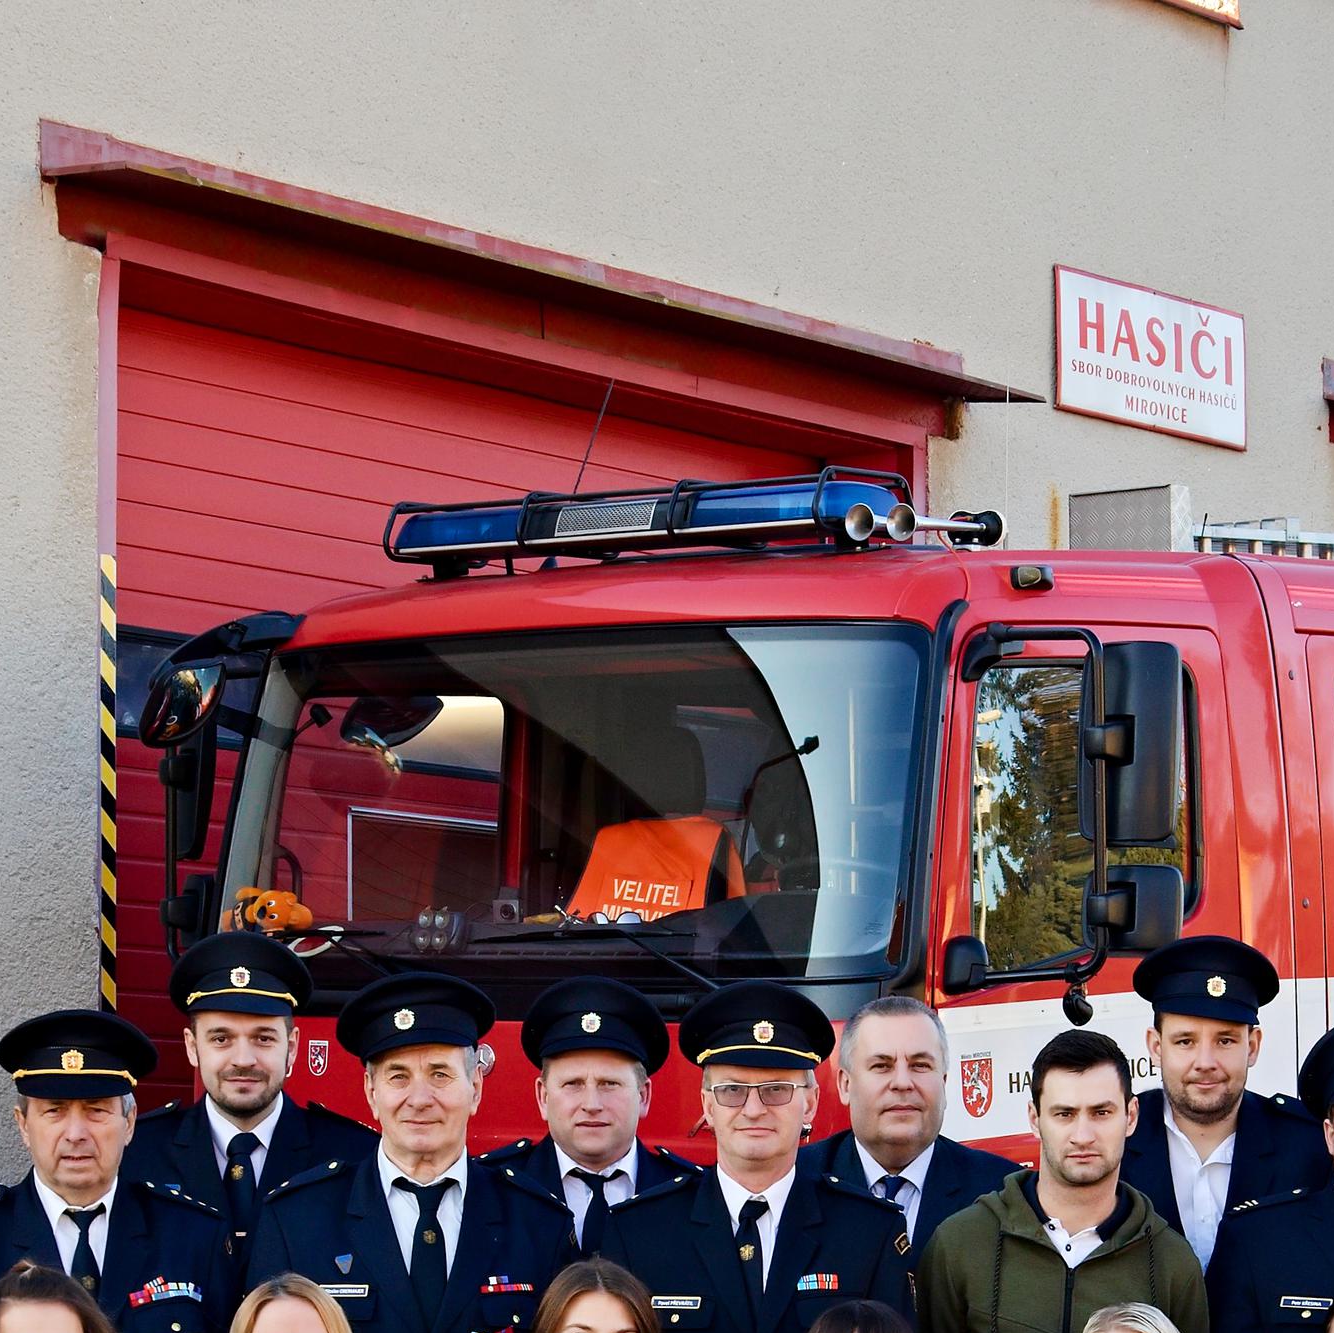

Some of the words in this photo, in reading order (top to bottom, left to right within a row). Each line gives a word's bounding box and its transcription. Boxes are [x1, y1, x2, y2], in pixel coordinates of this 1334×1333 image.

[1078, 297, 1233, 386] HASIČI
[1071, 359, 1102, 378] SBOR
[1106, 367, 1195, 401] DOBROVOLNÝCH
[1199, 390, 1237, 410] HASIČŮ
[1125, 394, 1188, 424] MIROVICE
[613, 878, 681, 907] VELITEL
